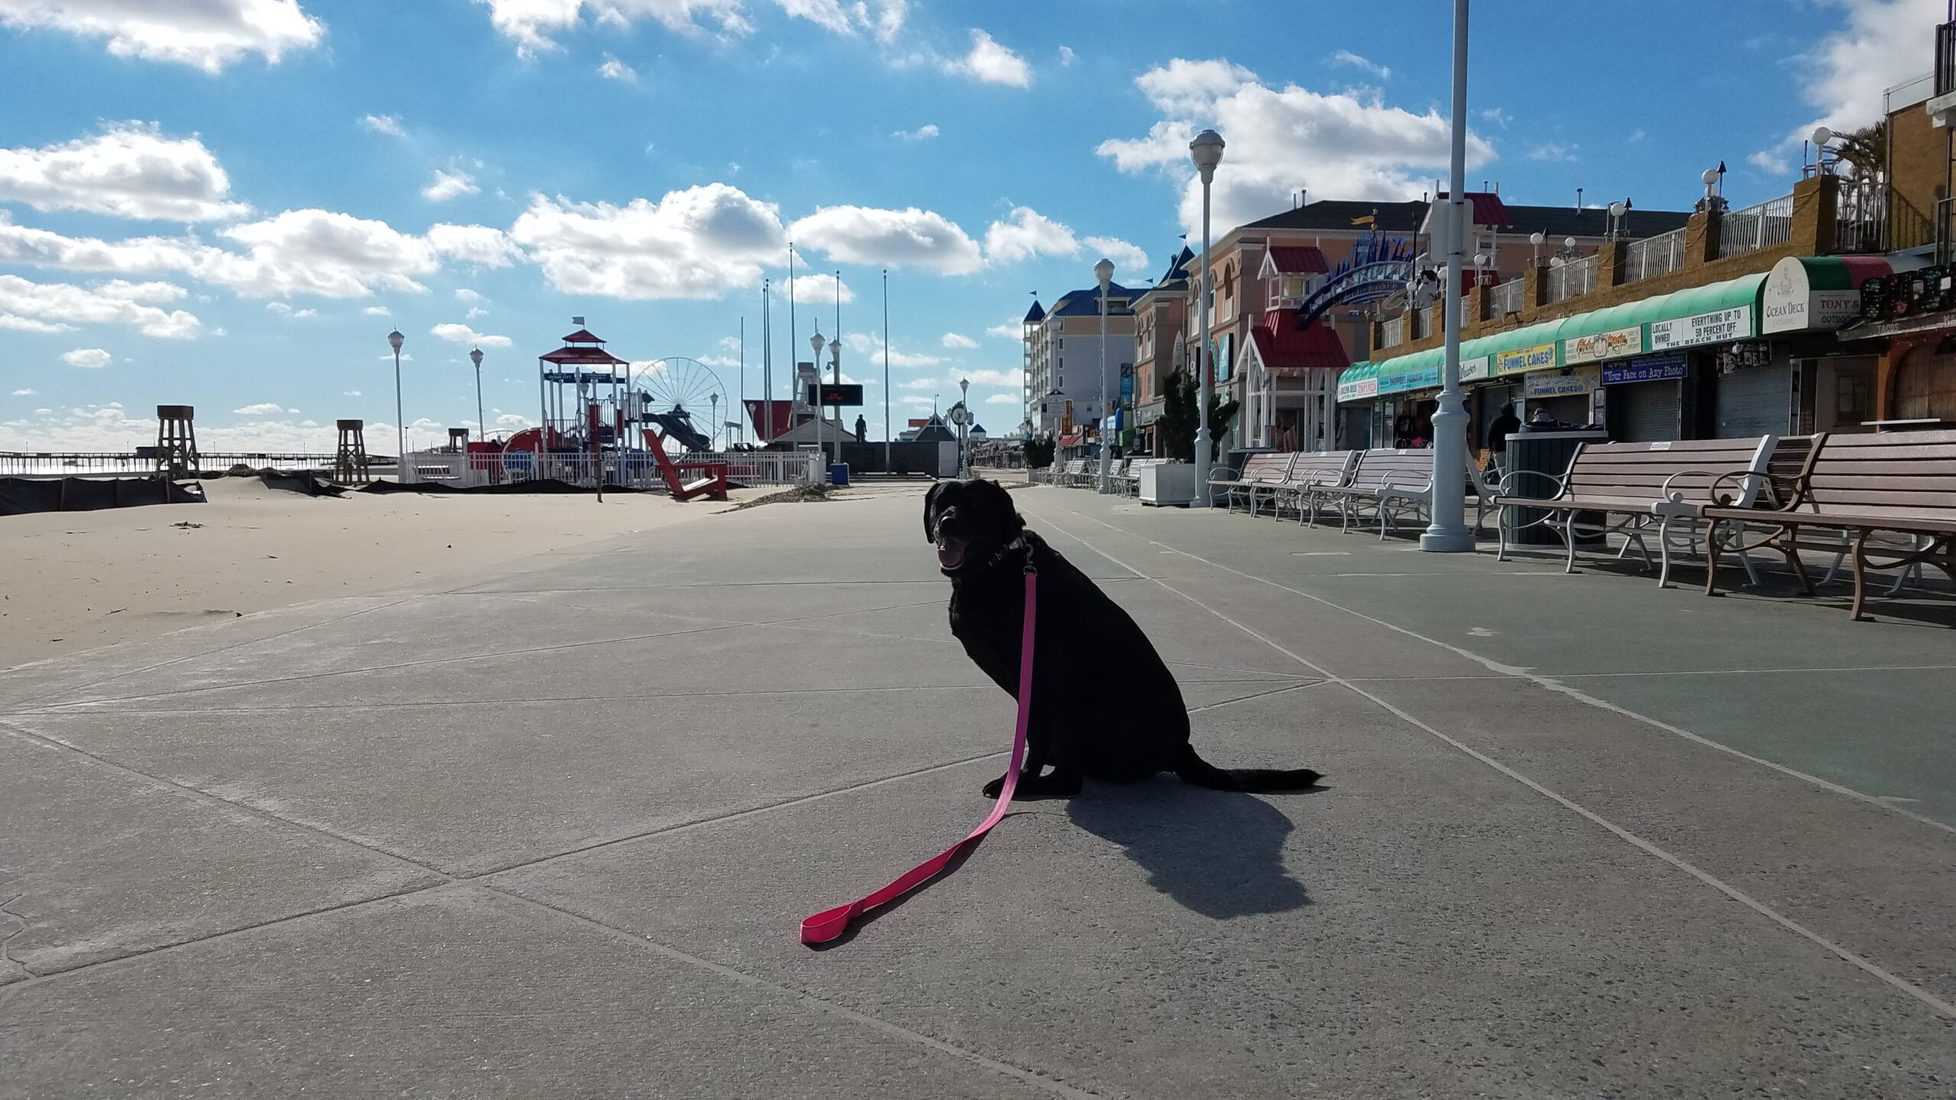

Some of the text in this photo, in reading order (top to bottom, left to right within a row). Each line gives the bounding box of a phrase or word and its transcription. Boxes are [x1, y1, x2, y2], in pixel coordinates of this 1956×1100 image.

[1692, 310, 1742, 327] EVERYTHING UP TO
[1652, 323, 1672, 334] LOCALLY
[1695, 322, 1736, 338] 50 PERCENT OFF
[1655, 333, 1670, 344] OWNED
[1685, 336, 1711, 344] BEACH
[1504, 355, 1526, 369] FUNNEL
[1528, 351, 1549, 365] CAKES
